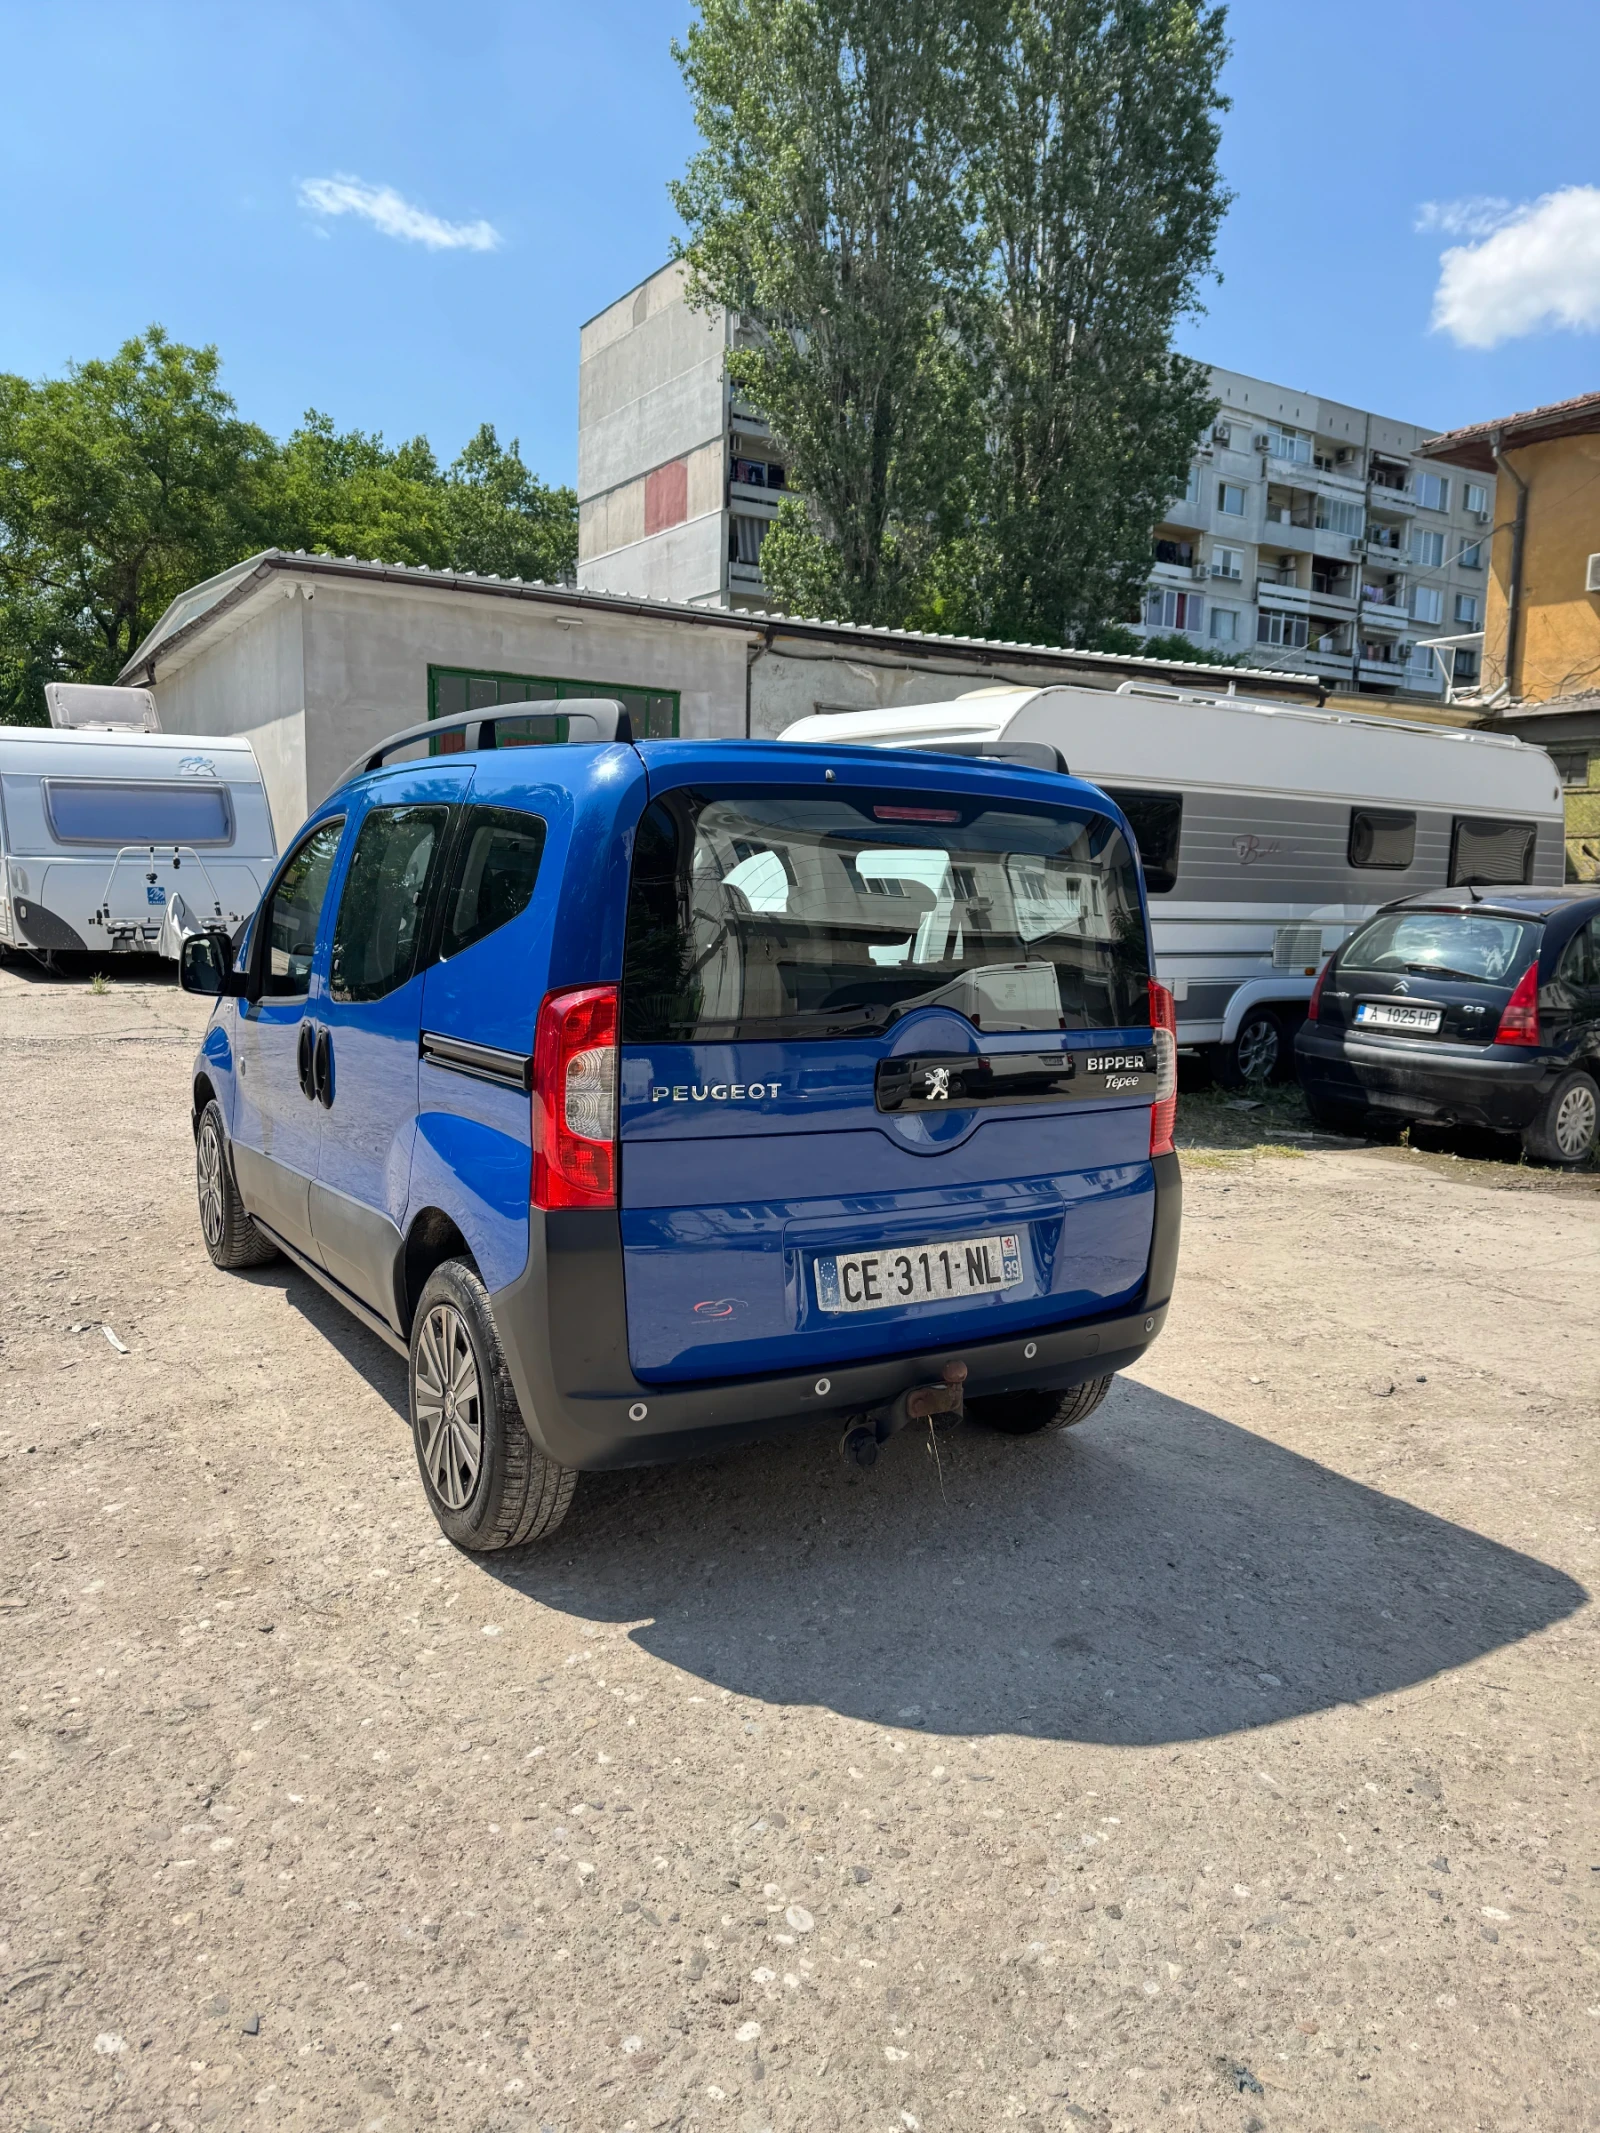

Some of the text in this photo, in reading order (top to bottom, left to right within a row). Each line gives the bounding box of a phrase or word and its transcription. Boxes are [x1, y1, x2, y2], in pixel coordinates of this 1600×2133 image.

[1370, 1006, 1438, 1026] A 1025 HP
[1087, 1055, 1144, 1070] BIPPER
[1105, 1074, 1140, 1090] Tepee
[652, 1083, 782, 1102] PEUGEOT
[842, 1245, 1001, 1303] CE-311-NL
[1004, 1259, 1019, 1279] 39
